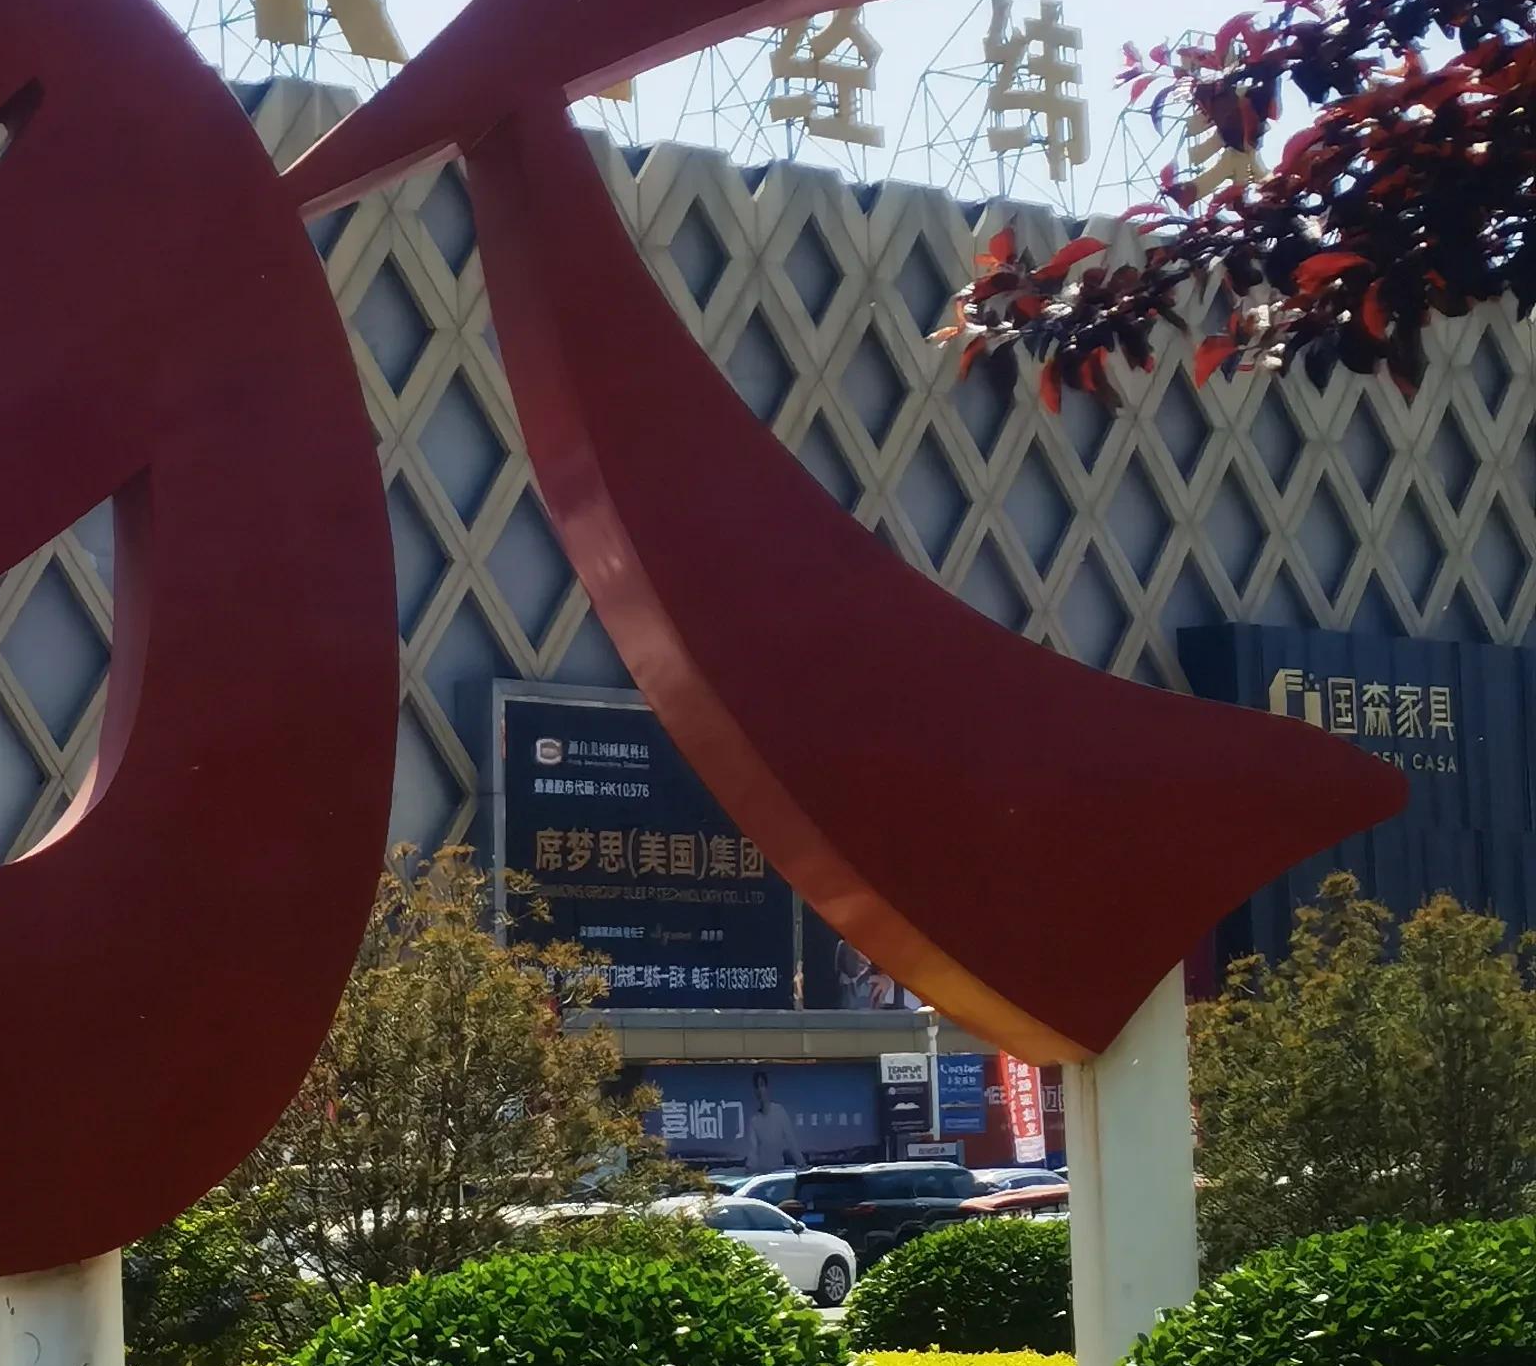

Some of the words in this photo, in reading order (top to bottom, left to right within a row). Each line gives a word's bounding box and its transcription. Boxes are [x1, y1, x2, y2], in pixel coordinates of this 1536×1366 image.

[1327, 676, 1455, 741] 国森家具
[1412, 753, 1457, 774] CASA
[660, 1099, 745, 1140] 喜临门
